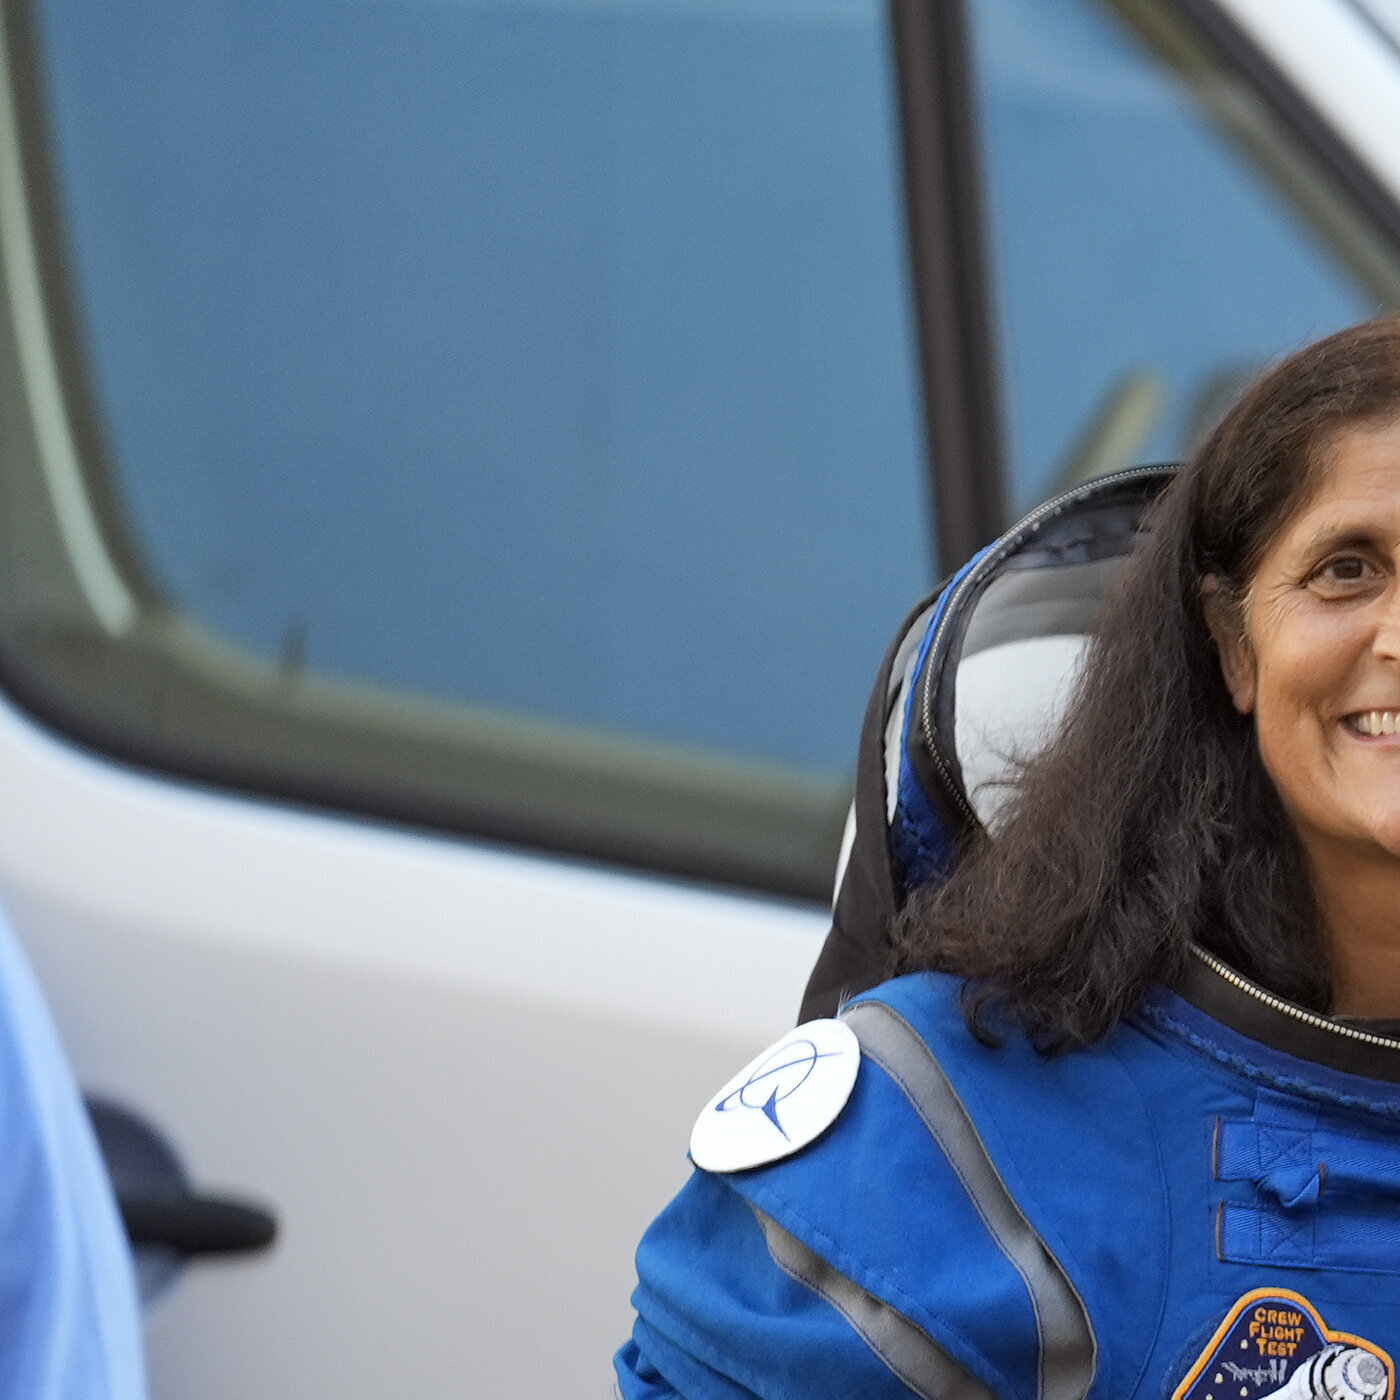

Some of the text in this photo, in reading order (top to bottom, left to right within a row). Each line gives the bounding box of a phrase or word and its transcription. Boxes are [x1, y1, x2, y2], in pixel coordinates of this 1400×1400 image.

[1254, 1307, 1302, 1326] CREW
[1249, 1321, 1304, 1342] FLIGHT
[1256, 1338, 1297, 1357] TEST
